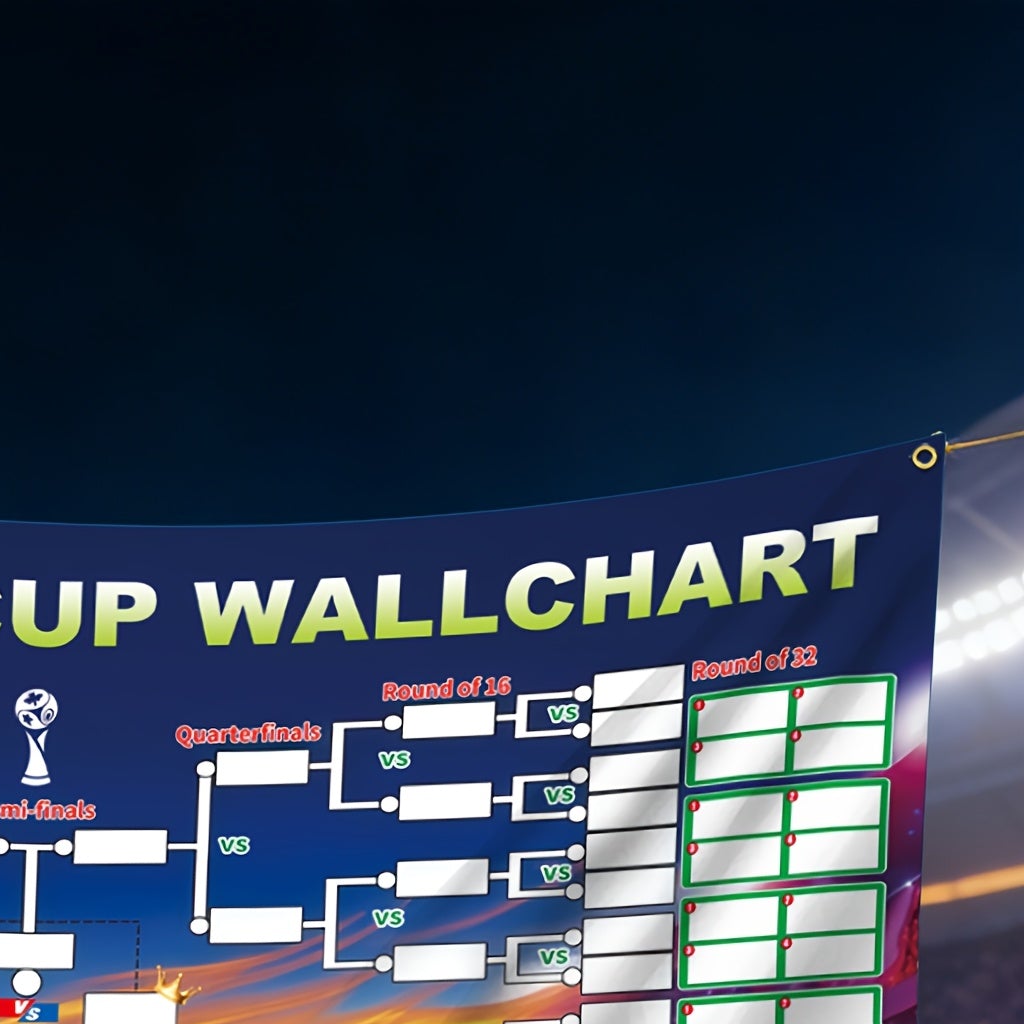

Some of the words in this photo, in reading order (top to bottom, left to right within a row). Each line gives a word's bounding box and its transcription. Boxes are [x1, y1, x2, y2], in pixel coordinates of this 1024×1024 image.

[194, 516, 878, 645] WALLCHART
[692, 650, 762, 681] Round
[765, 646, 790, 670] of
[790, 645, 817, 668] 32
[382, 678, 454, 701] Round
[457, 676, 482, 697] of
[484, 676, 511, 695] 16
[175, 722, 321, 748] Quarterfinals
[14, 1000, 41, 1021] VS
